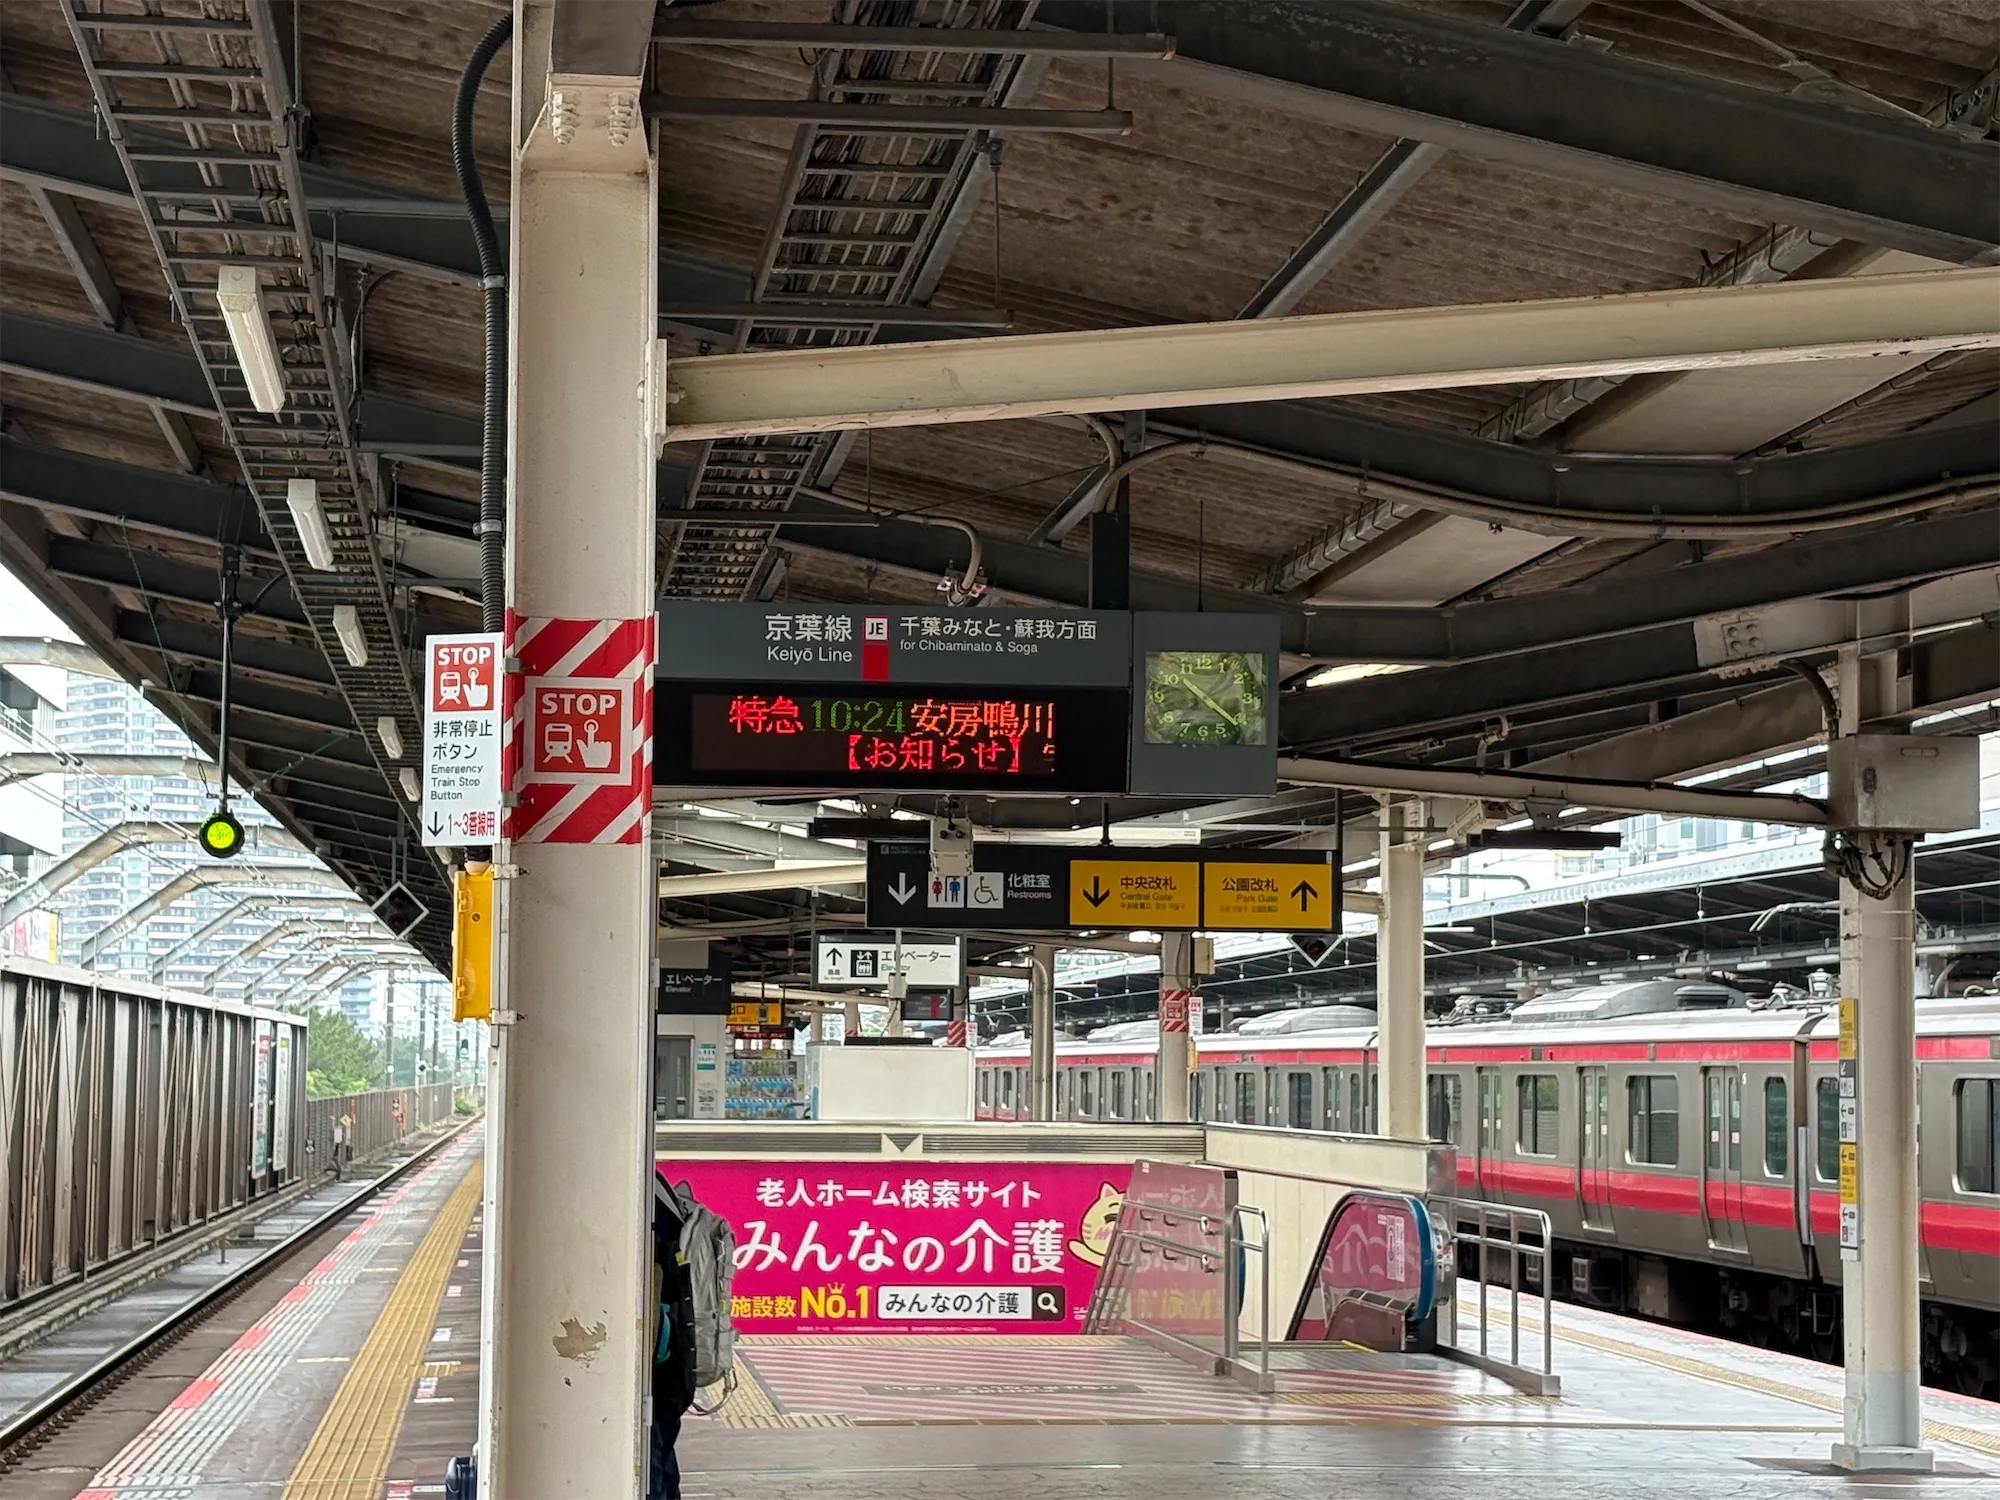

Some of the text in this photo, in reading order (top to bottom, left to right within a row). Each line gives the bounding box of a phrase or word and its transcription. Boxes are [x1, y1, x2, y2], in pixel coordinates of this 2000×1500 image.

[765, 614, 852, 642] 京葉線
[868, 622, 884, 635] JE
[900, 617, 1096, 640] 千葉みなと・蘇我方面
[767, 646, 852, 665] Keiyō Line
[900, 640, 1038, 654] for Chibaminato & Soga
[438, 647, 491, 666] STOP
[542, 693, 616, 715] STOP
[729, 695, 1055, 737] 特急 10:24 安房鴨川
[433, 719, 493, 738] 非常停止
[433, 743, 478, 760] ボタン
[849, 734, 1021, 773] 【お知らせ】
[431, 764, 484, 775] Emergency
[431, 777, 480, 788] Train Stop
[430, 790, 463, 801] Button
[1007, 873, 1051, 888] 化粧室
[1120, 876, 1177, 891] 中央改札
[1222, 877, 1279, 892] 公園改札
[1007, 890, 1052, 899] Restrooms
[1120, 892, 1173, 901] Central Gate
[1236, 893, 1279, 903] Park Gate
[939, 995, 948, 1009] 2
[756, 1177, 1041, 1209] 老人ホーム検索サイト
[732, 1218, 1066, 1274] みんなの介護
[730, 1286, 868, 1319] 施設数 No.1
[885, 1292, 1019, 1314] みんなの介護
